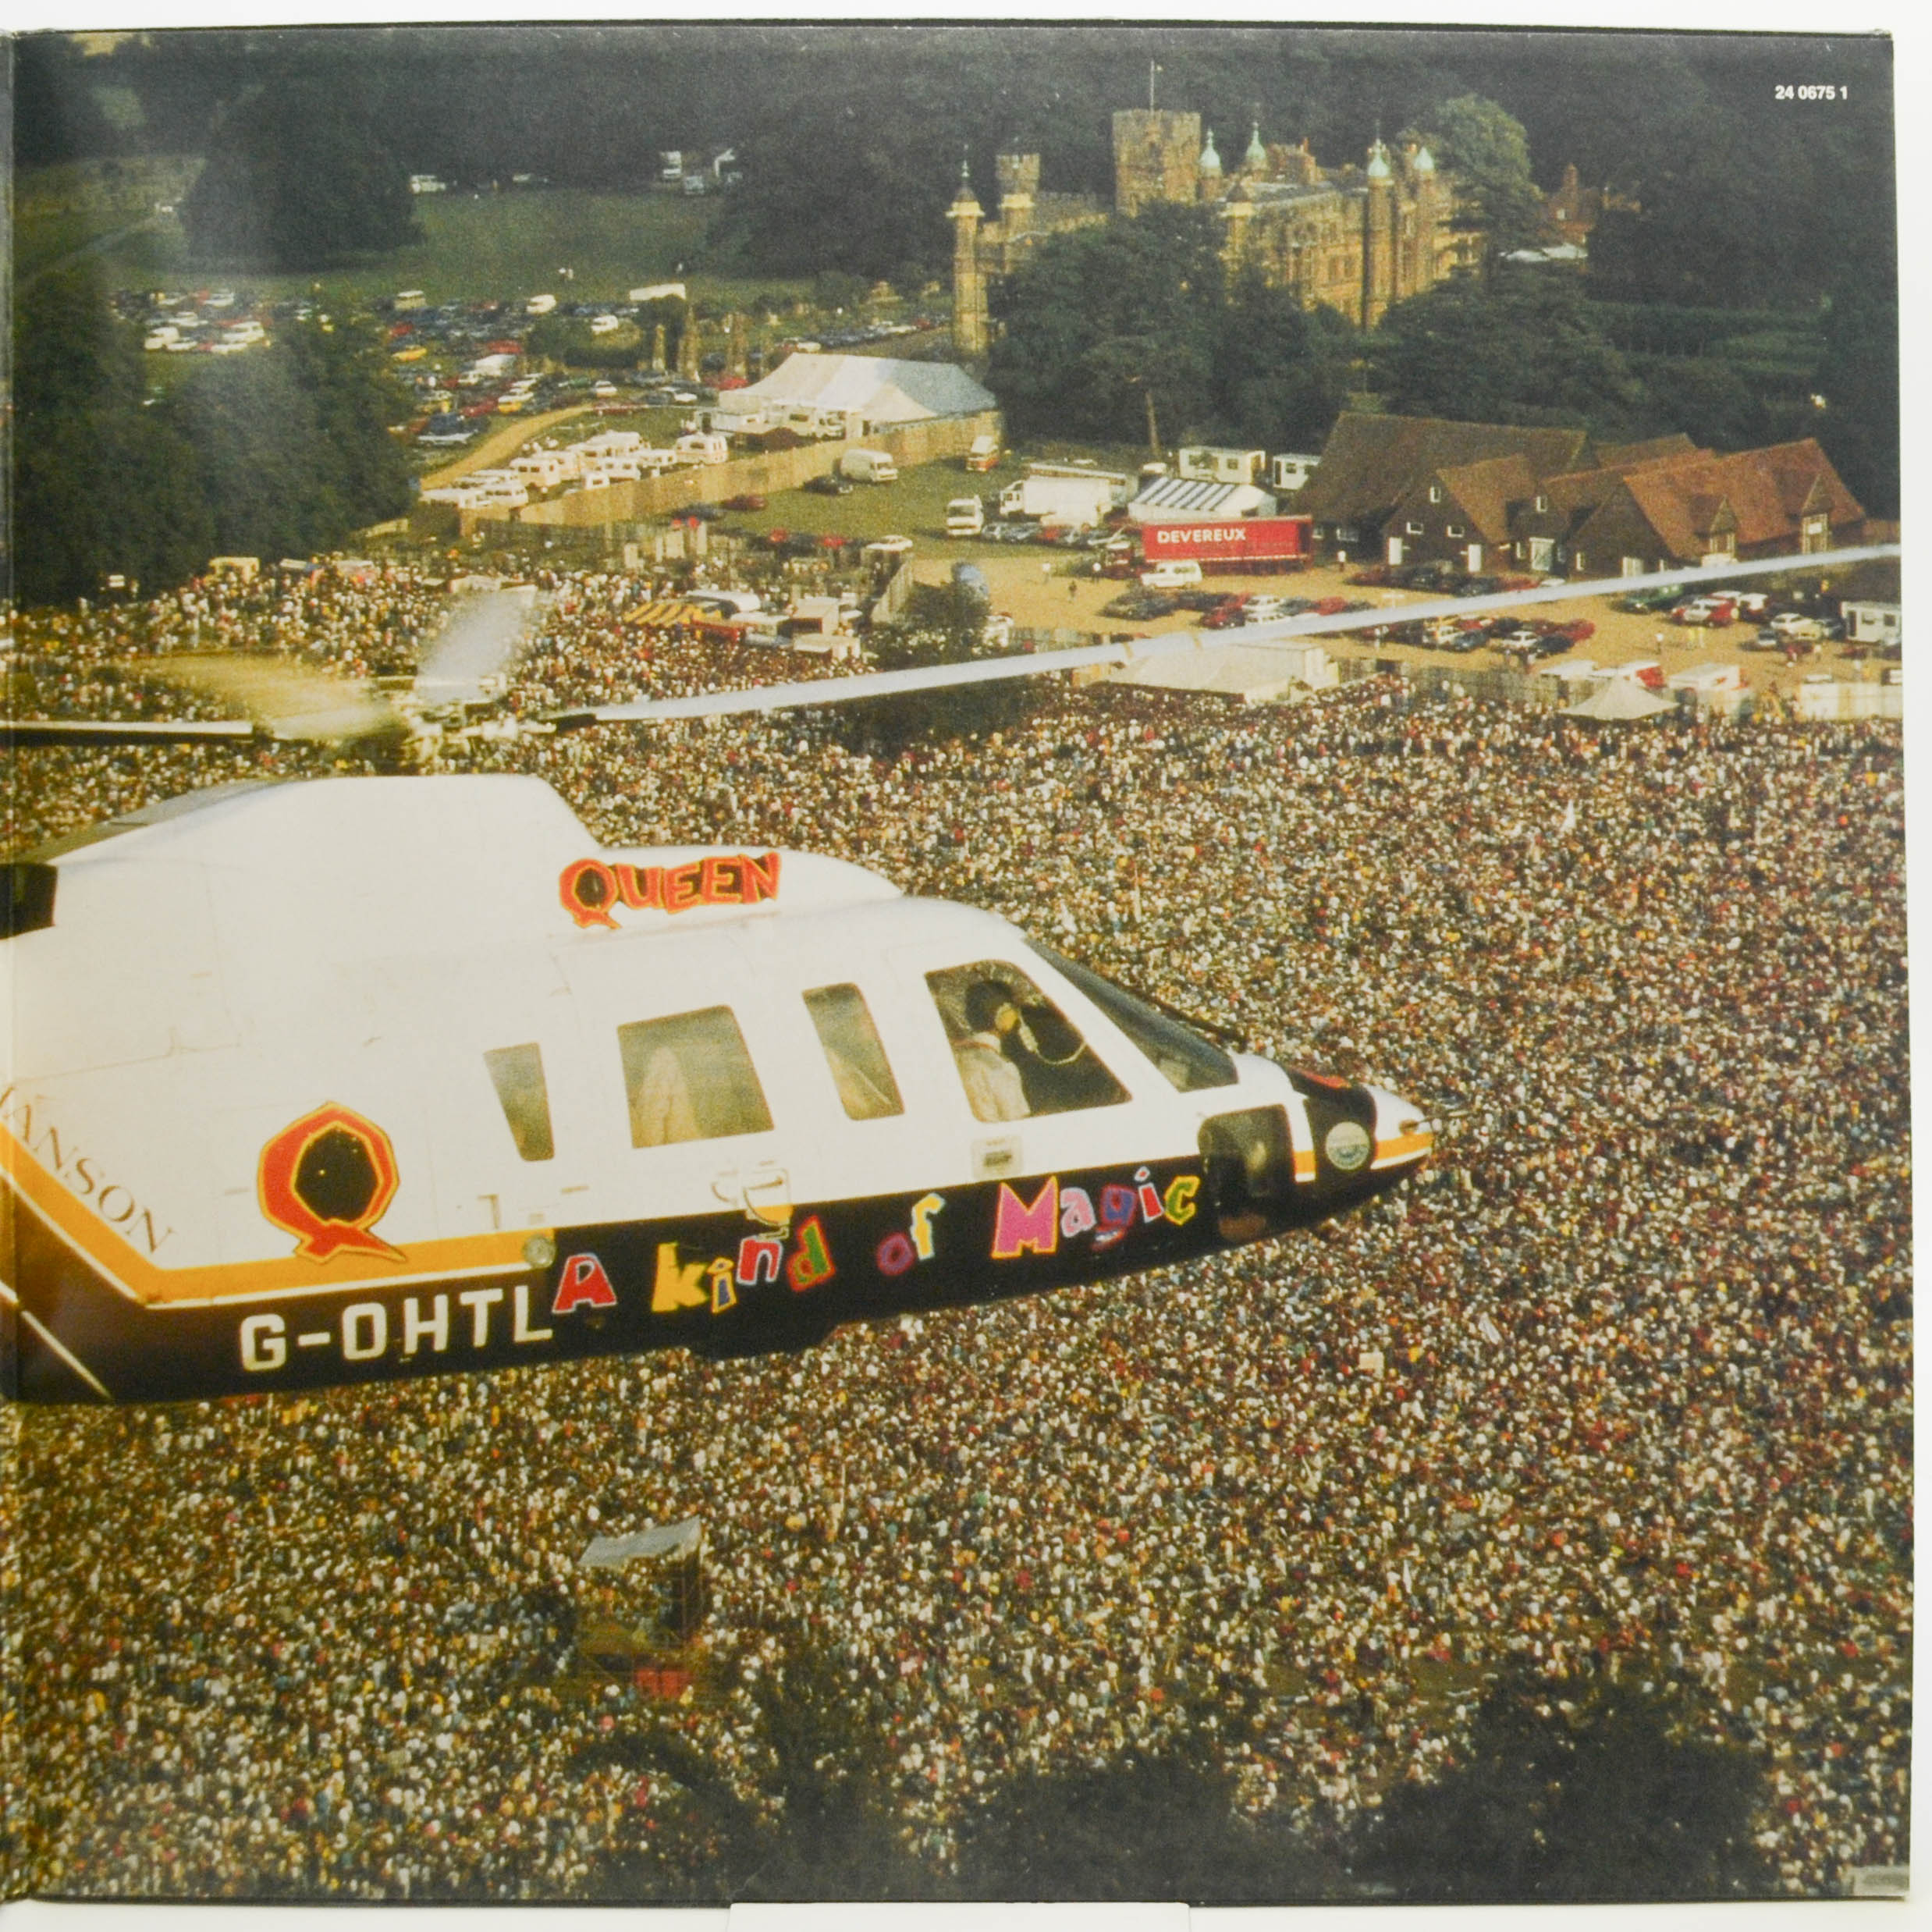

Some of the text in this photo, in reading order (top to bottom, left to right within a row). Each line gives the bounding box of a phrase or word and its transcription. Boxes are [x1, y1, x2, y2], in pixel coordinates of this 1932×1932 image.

[1774, 84, 1848, 101] 24 0675 1
[1156, 527, 1247, 544] DEVEREUX
[559, 851, 783, 929] QUEEN
[257, 1101, 408, 1265] Q
[551, 1166, 1201, 1315] A kind of Magic
[240, 1284, 553, 1372] G-OHTL
